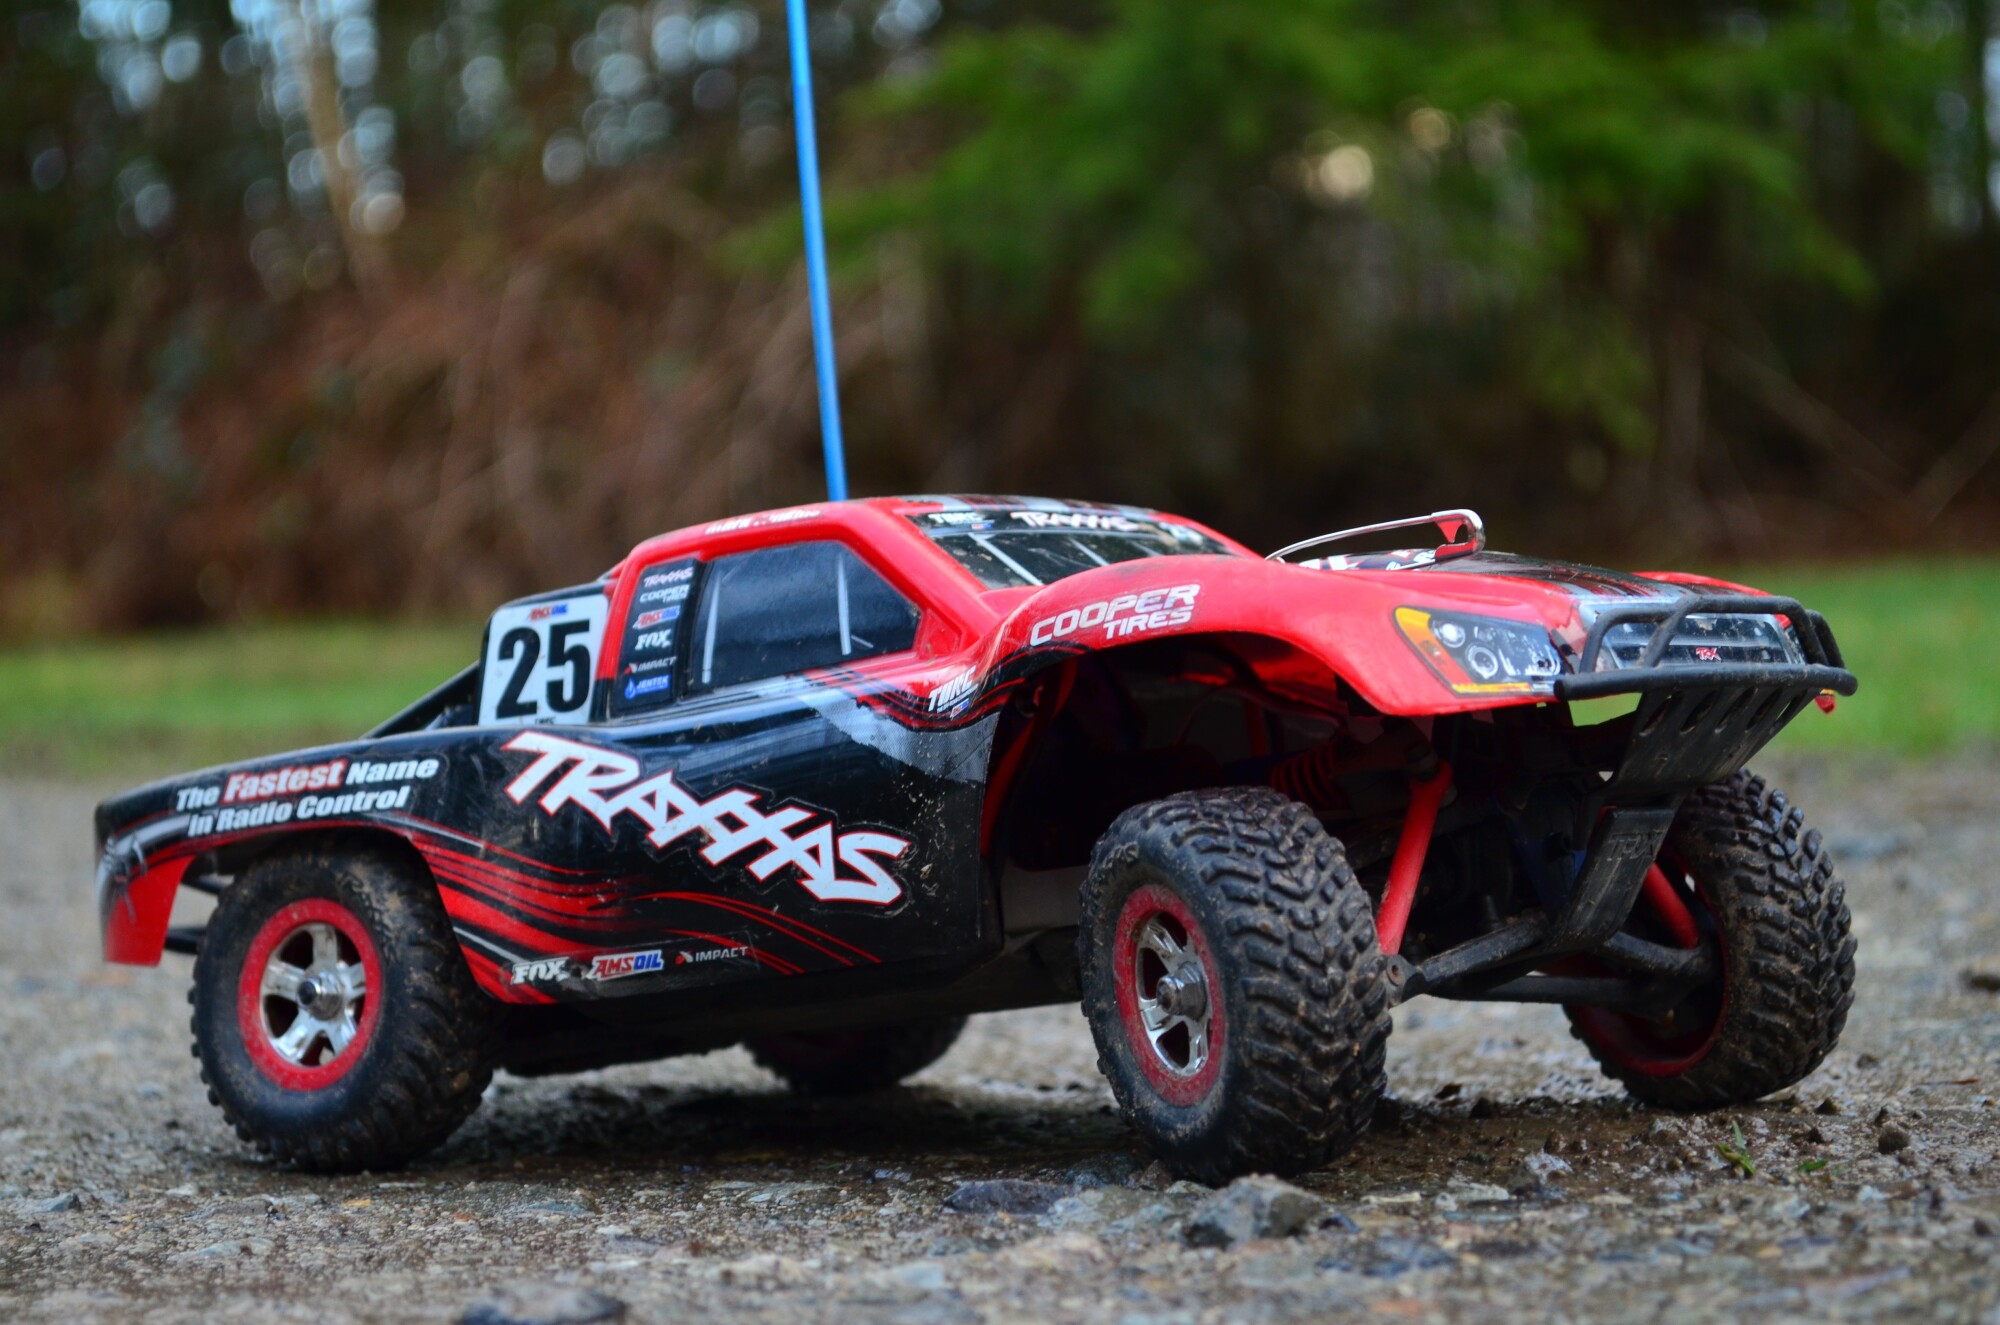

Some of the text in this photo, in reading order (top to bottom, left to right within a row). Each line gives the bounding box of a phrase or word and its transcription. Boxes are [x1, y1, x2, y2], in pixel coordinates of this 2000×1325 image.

[639, 584, 690, 603] COOPER
[1030, 584, 1200, 647] COOPER
[1103, 607, 1195, 640] TIRES
[495, 619, 592, 719] 25
[637, 656, 677, 671] IMPACT
[176, 758, 440, 812] The Fastest Name
[187, 785, 411, 837] In Radio Control
[501, 731, 911, 904] TRAXXAS
[511, 946, 749, 985] FOX AMSOIL IMPACT
